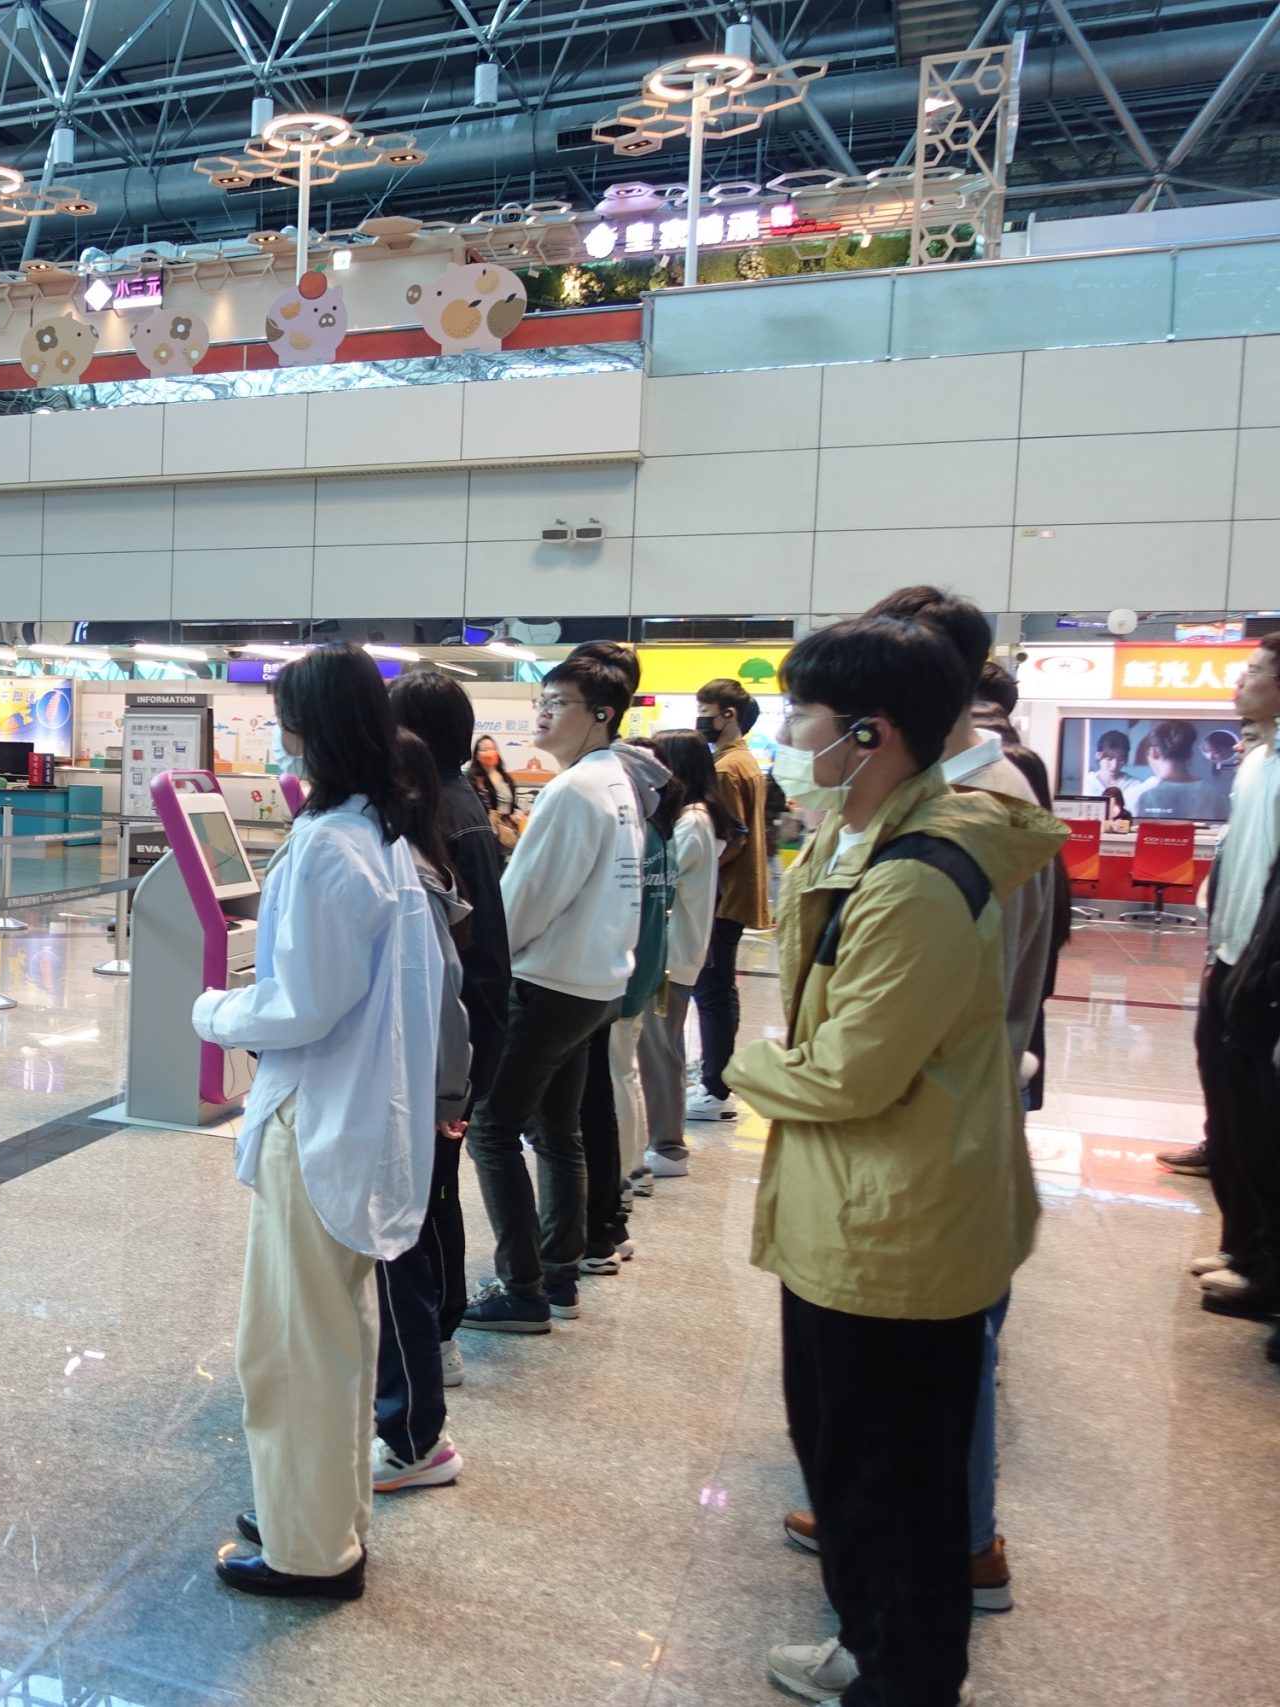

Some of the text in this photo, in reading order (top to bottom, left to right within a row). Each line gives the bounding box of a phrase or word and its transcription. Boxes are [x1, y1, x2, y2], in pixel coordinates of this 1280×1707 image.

[115, 276, 161, 299] 小三元
[136, 695, 196, 704] INFORMATION
[135, 844, 161, 853] EVA
